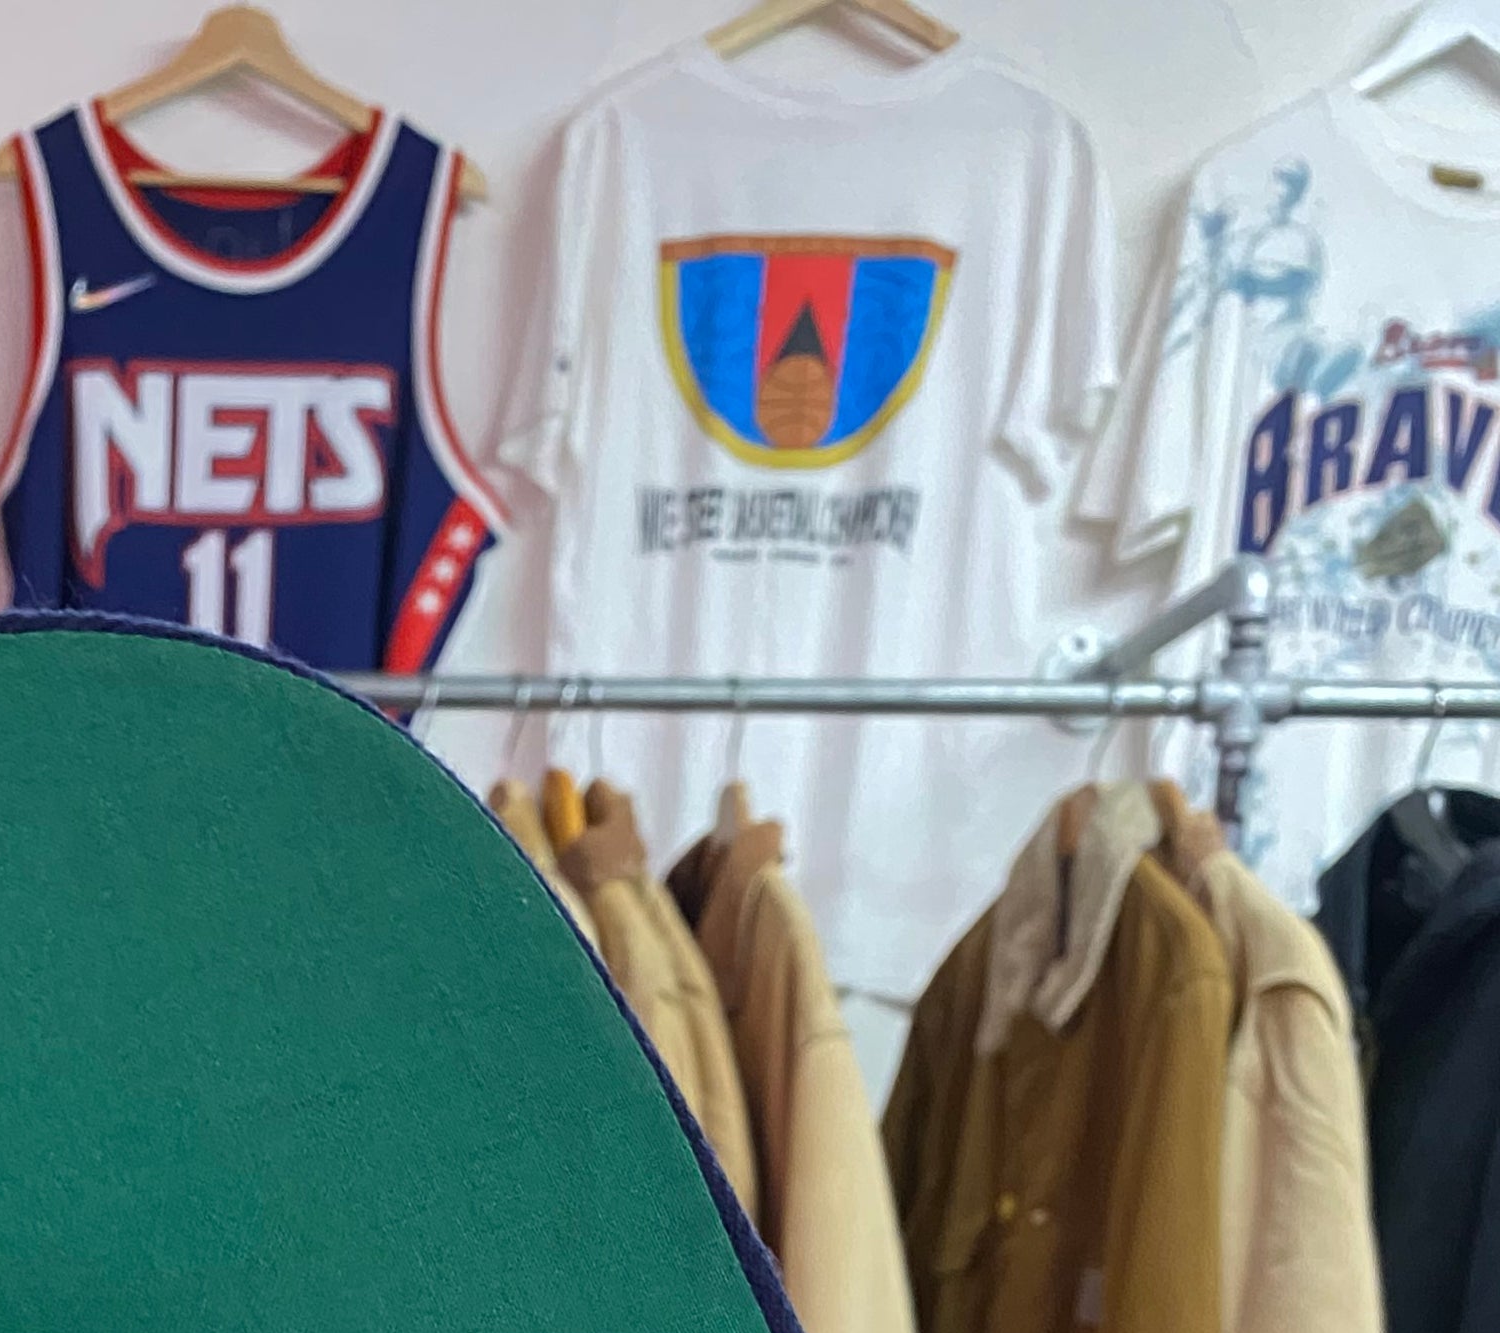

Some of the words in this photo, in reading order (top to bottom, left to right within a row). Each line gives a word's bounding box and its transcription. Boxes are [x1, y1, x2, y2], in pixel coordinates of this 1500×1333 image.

[67, 358, 396, 583] NETS
[1237, 387, 1500, 556] BRAV
[183, 529, 274, 648] 11
